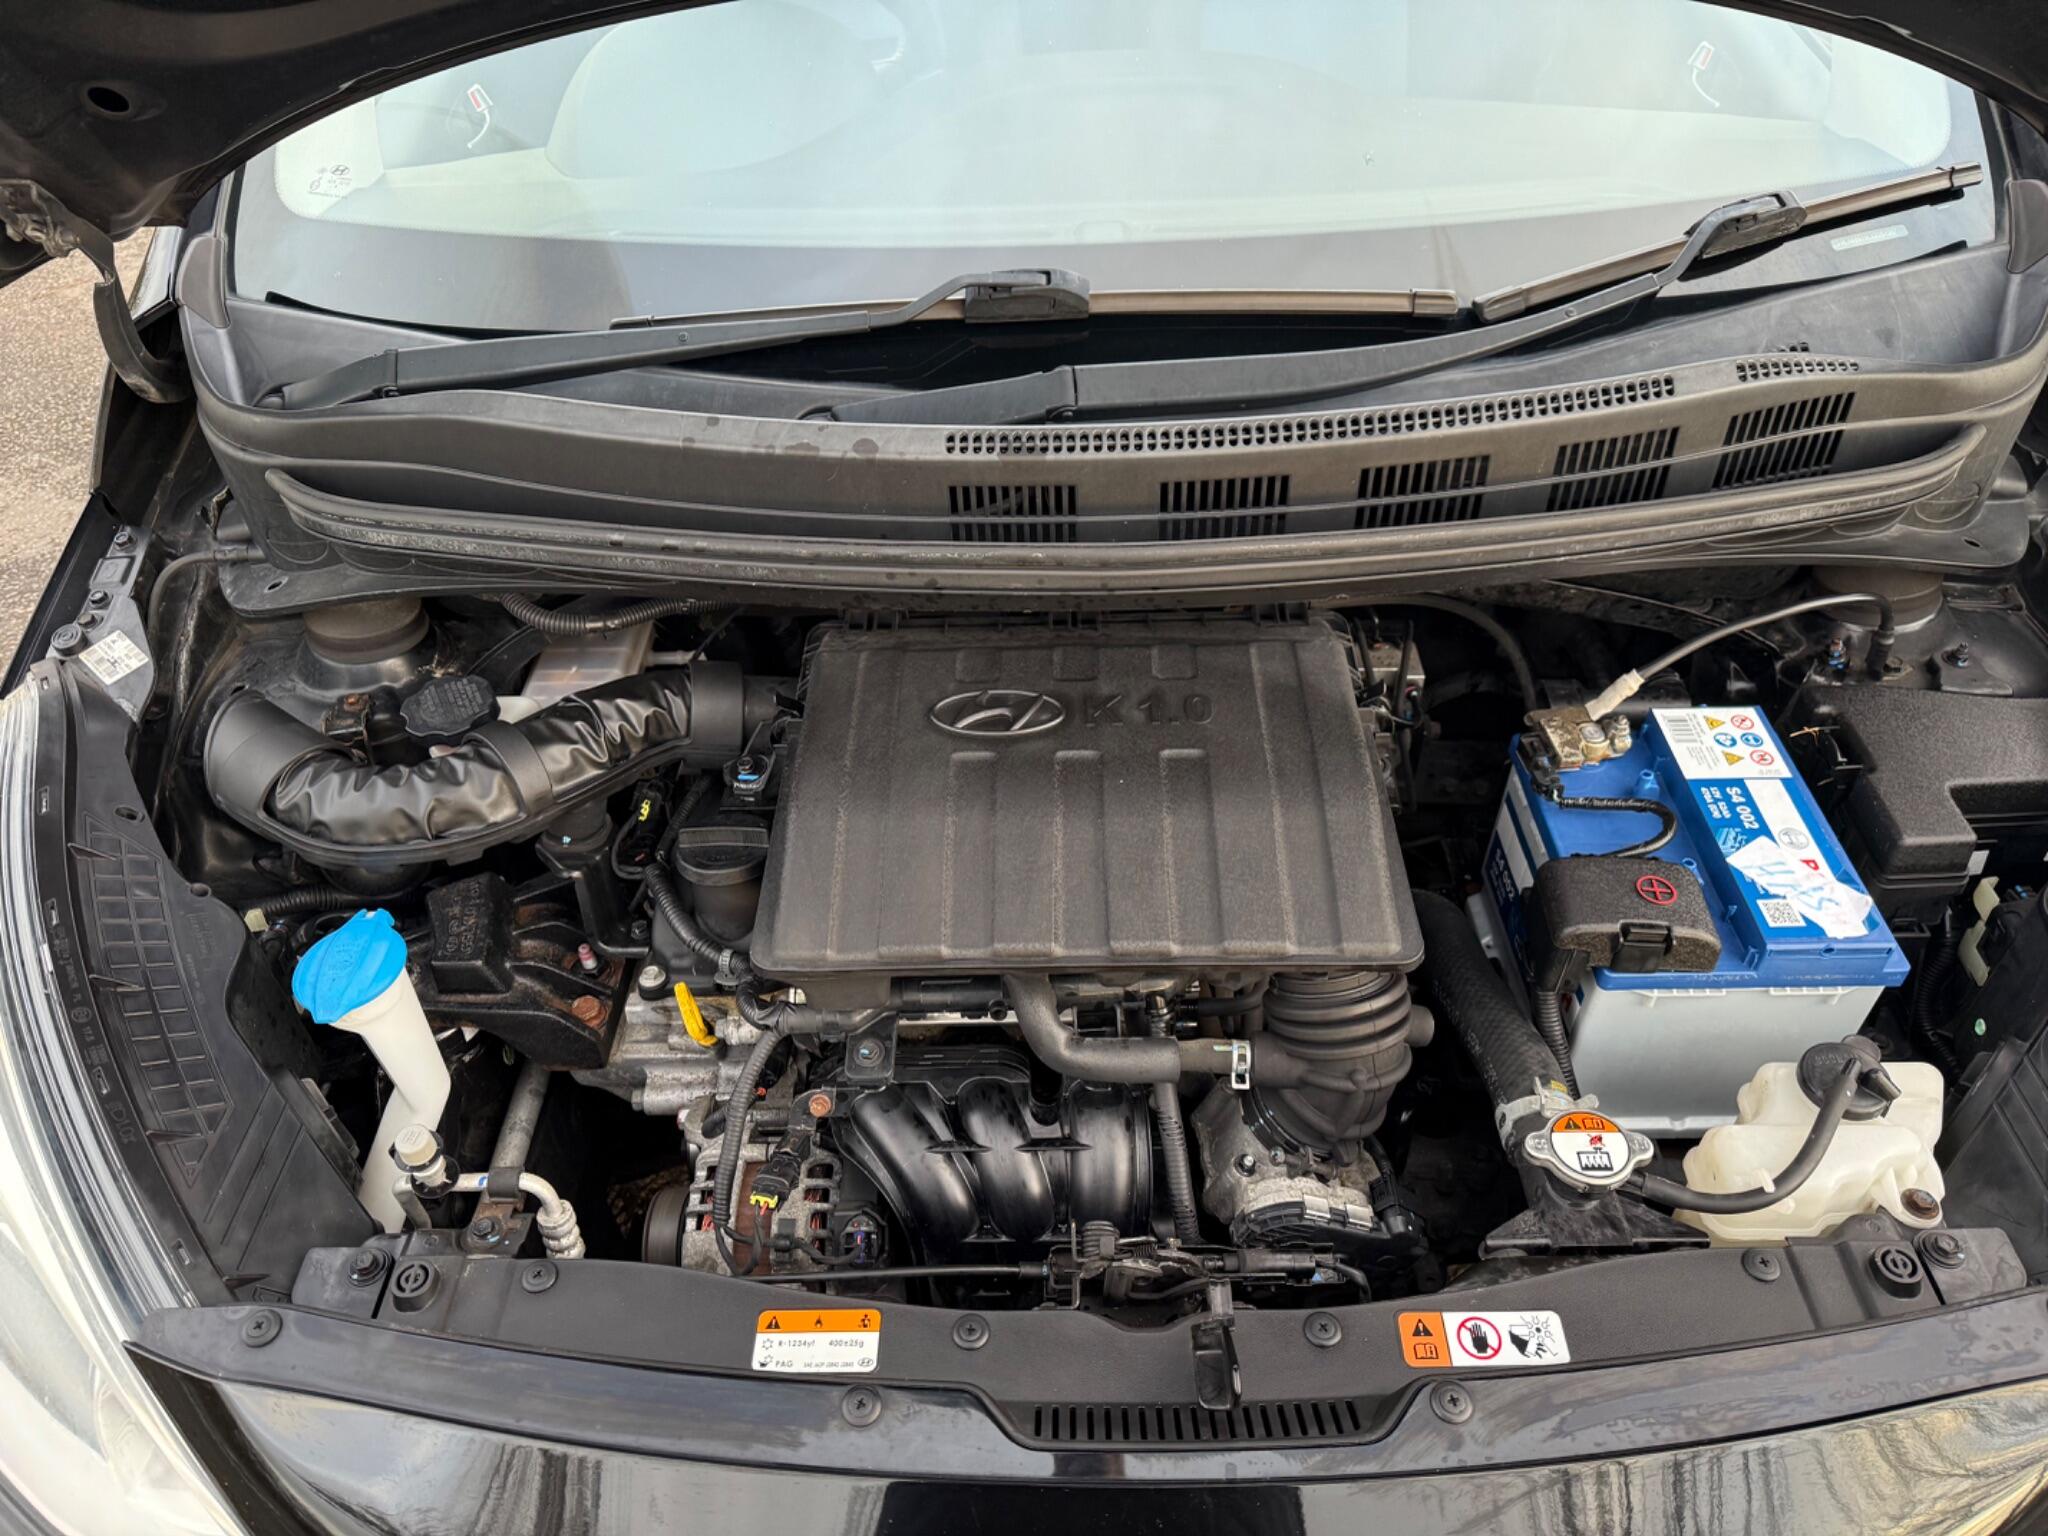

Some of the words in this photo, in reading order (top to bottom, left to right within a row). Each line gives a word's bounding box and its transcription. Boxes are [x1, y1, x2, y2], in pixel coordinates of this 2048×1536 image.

[1085, 693, 1126, 729] K
[1137, 692, 1217, 727] 1.0
[1726, 786, 1746, 803] S4
[1736, 802, 1760, 829] 002
[775, 1360, 794, 1368] PAG
